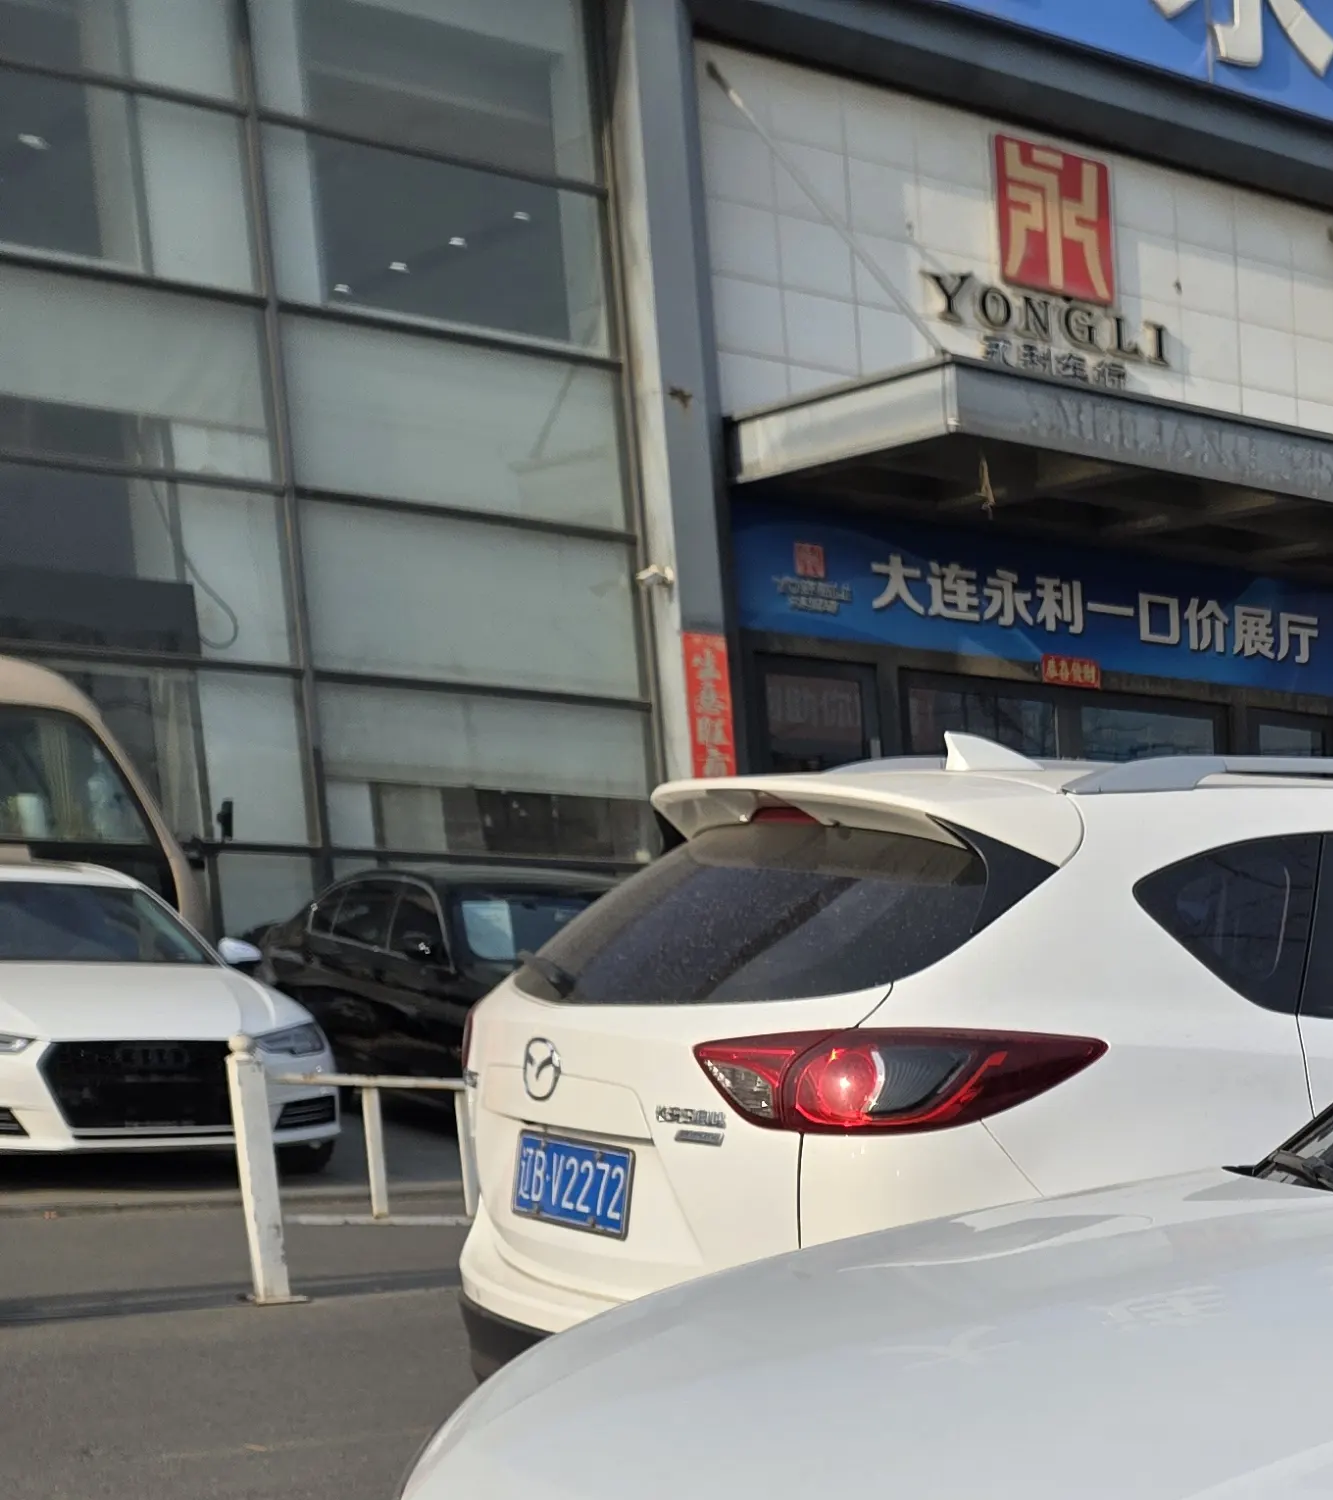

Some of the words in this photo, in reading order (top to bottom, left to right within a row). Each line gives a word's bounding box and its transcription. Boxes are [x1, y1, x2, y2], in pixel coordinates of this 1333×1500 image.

[919, 269, 1170, 367] YONGLI
[871, 554, 1319, 664] 大连永利一口价展厅
